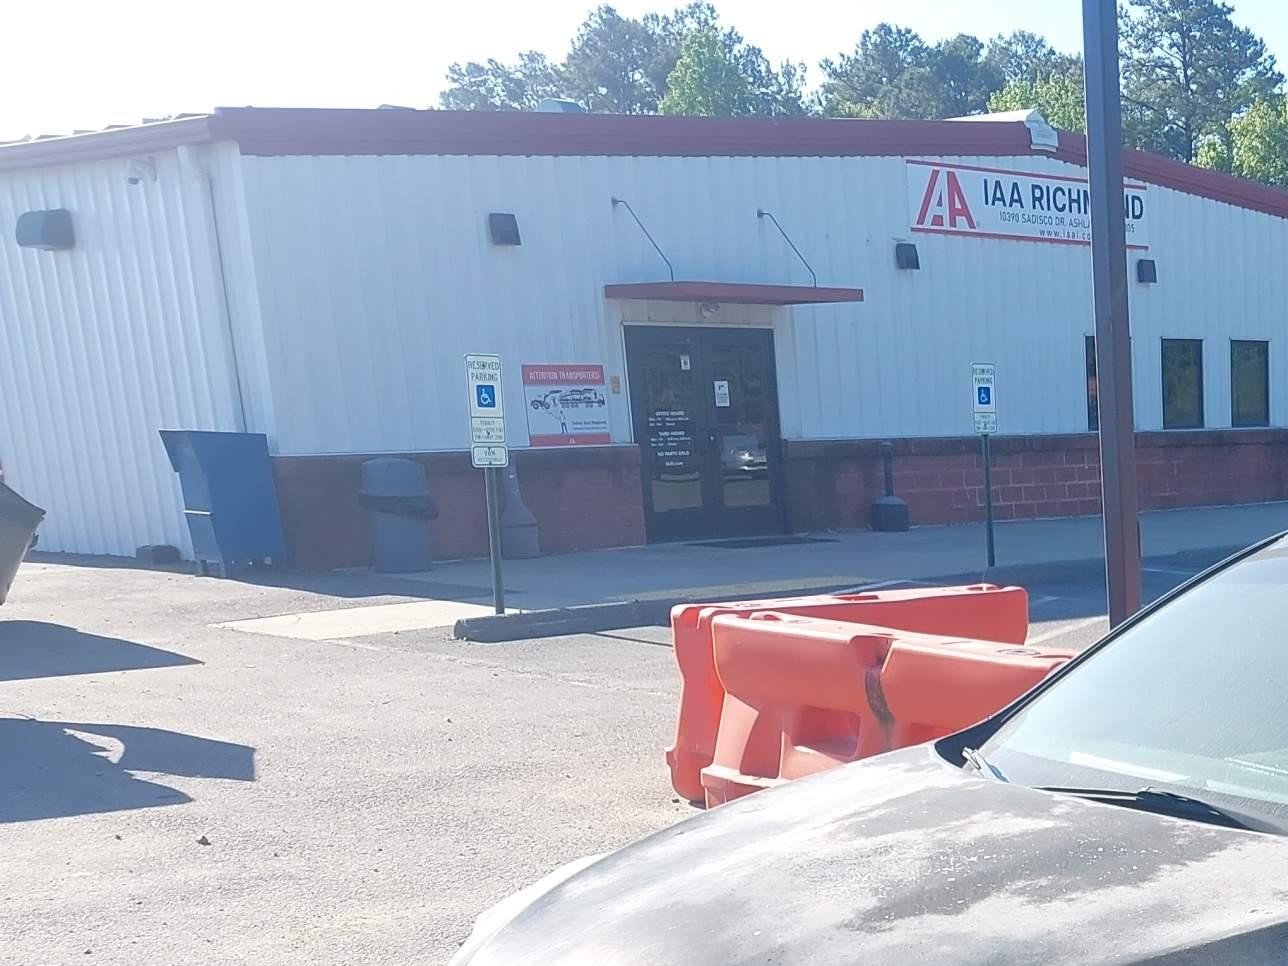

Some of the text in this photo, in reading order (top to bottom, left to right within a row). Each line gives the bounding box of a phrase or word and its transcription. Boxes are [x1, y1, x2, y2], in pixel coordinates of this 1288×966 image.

[983, 178, 1144, 220] IAA RICHD
[999, 210, 1020, 224] 10390
[1021, 213, 1053, 226] SADISCO
[1068, 217, 1090, 229] ASHL
[1039, 229, 1091, 241] www.iaai.co
[467, 360, 500, 370] RESERVED
[470, 372, 498, 382] PARKING
